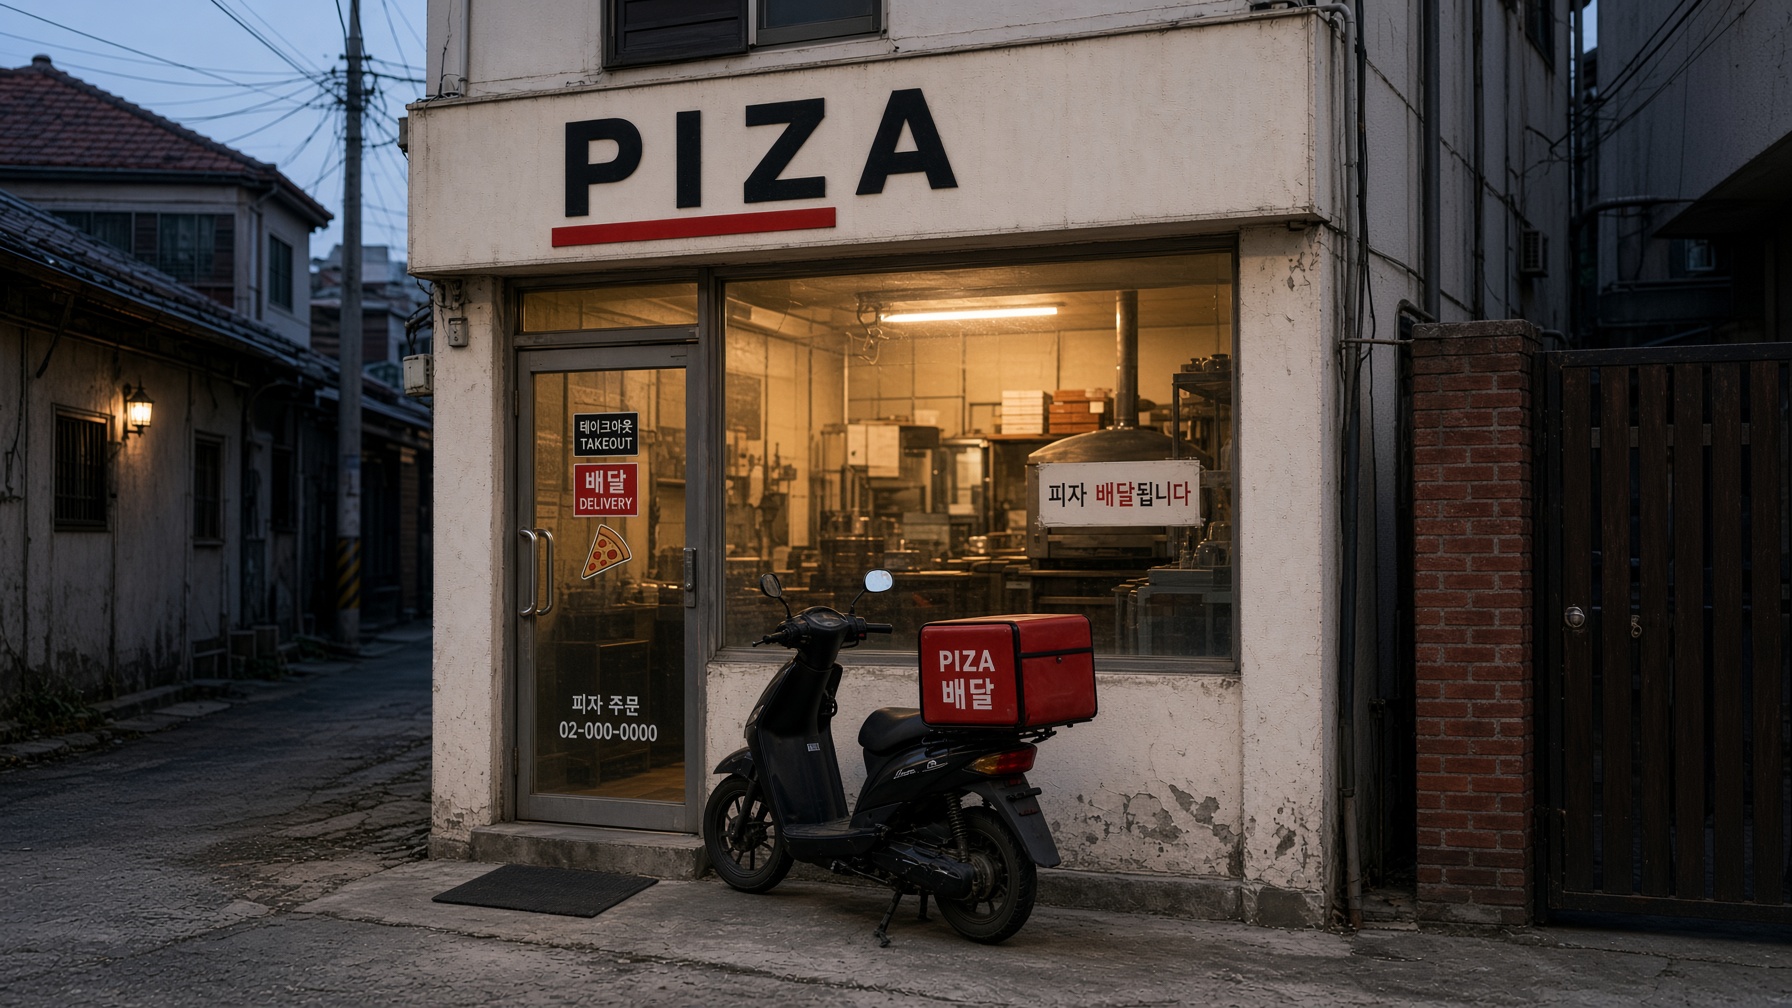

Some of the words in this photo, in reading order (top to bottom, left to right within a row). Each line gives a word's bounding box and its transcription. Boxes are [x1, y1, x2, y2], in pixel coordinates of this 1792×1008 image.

[565, 87, 959, 218] PIZA
[579, 419, 633, 434] 테이크아웃
[580, 437, 633, 450] TAKEOUT
[585, 469, 627, 494] 배달
[579, 497, 633, 510] DELIVERY
[1048, 482, 1088, 507] 피자
[1096, 481, 1192, 507] 배달됩니다
[939, 649, 996, 672] PIZA
[572, 693, 604, 715] 피자
[608, 695, 640, 716] 주문
[941, 677, 995, 710] 배달
[559, 721, 658, 742] 02-000-0000
